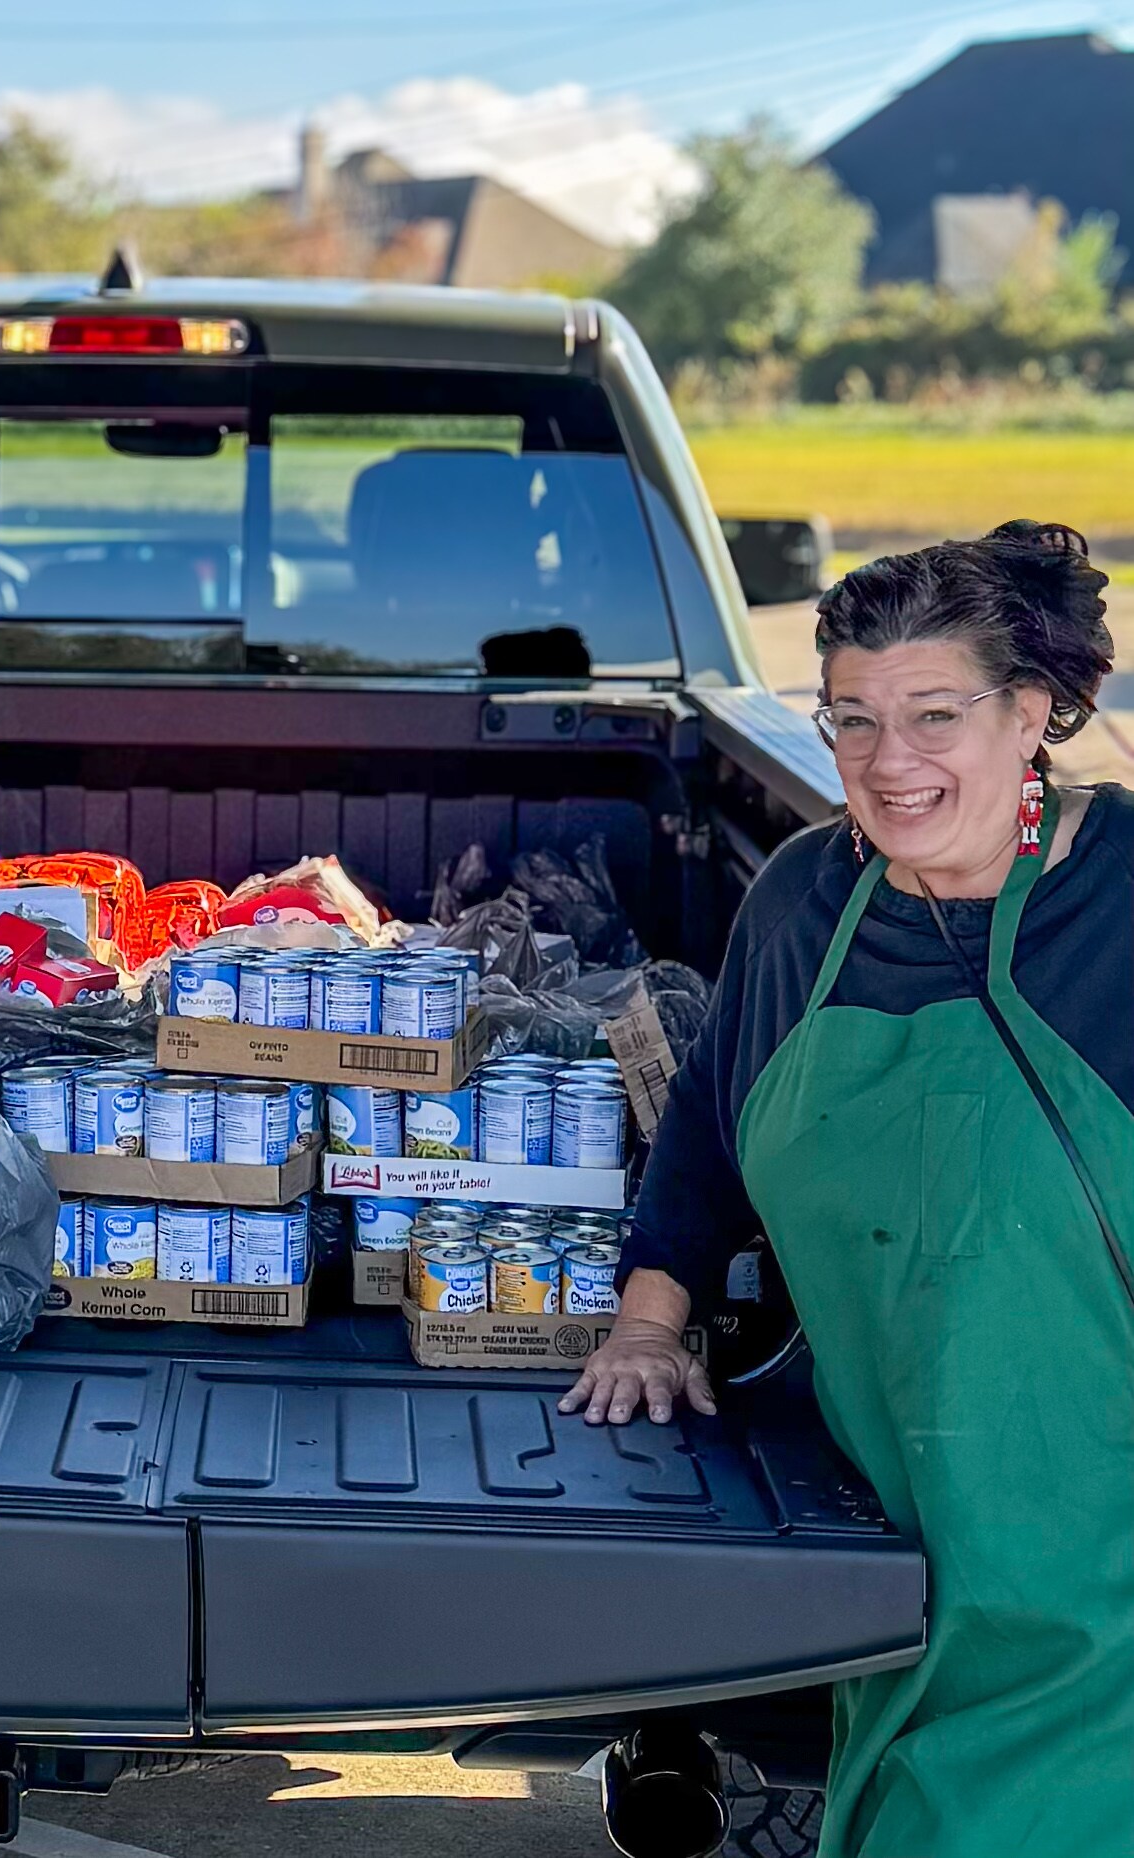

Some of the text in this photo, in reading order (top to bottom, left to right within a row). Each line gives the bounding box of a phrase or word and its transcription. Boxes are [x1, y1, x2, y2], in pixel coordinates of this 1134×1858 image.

[264, 1042, 289, 1052] PINTO
[436, 1119, 452, 1128] Cut
[386, 1173, 405, 1182] You
[408, 1170, 427, 1181] will
[430, 1170, 450, 1180] like
[415, 1178, 491, 1193] on your table!
[101, 1286, 147, 1299] Whole
[571, 1291, 615, 1309] Chicken
[82, 1301, 126, 1314] Kernel
[130, 1303, 167, 1317] Corn
[481, 1336, 508, 1344] CREAM
